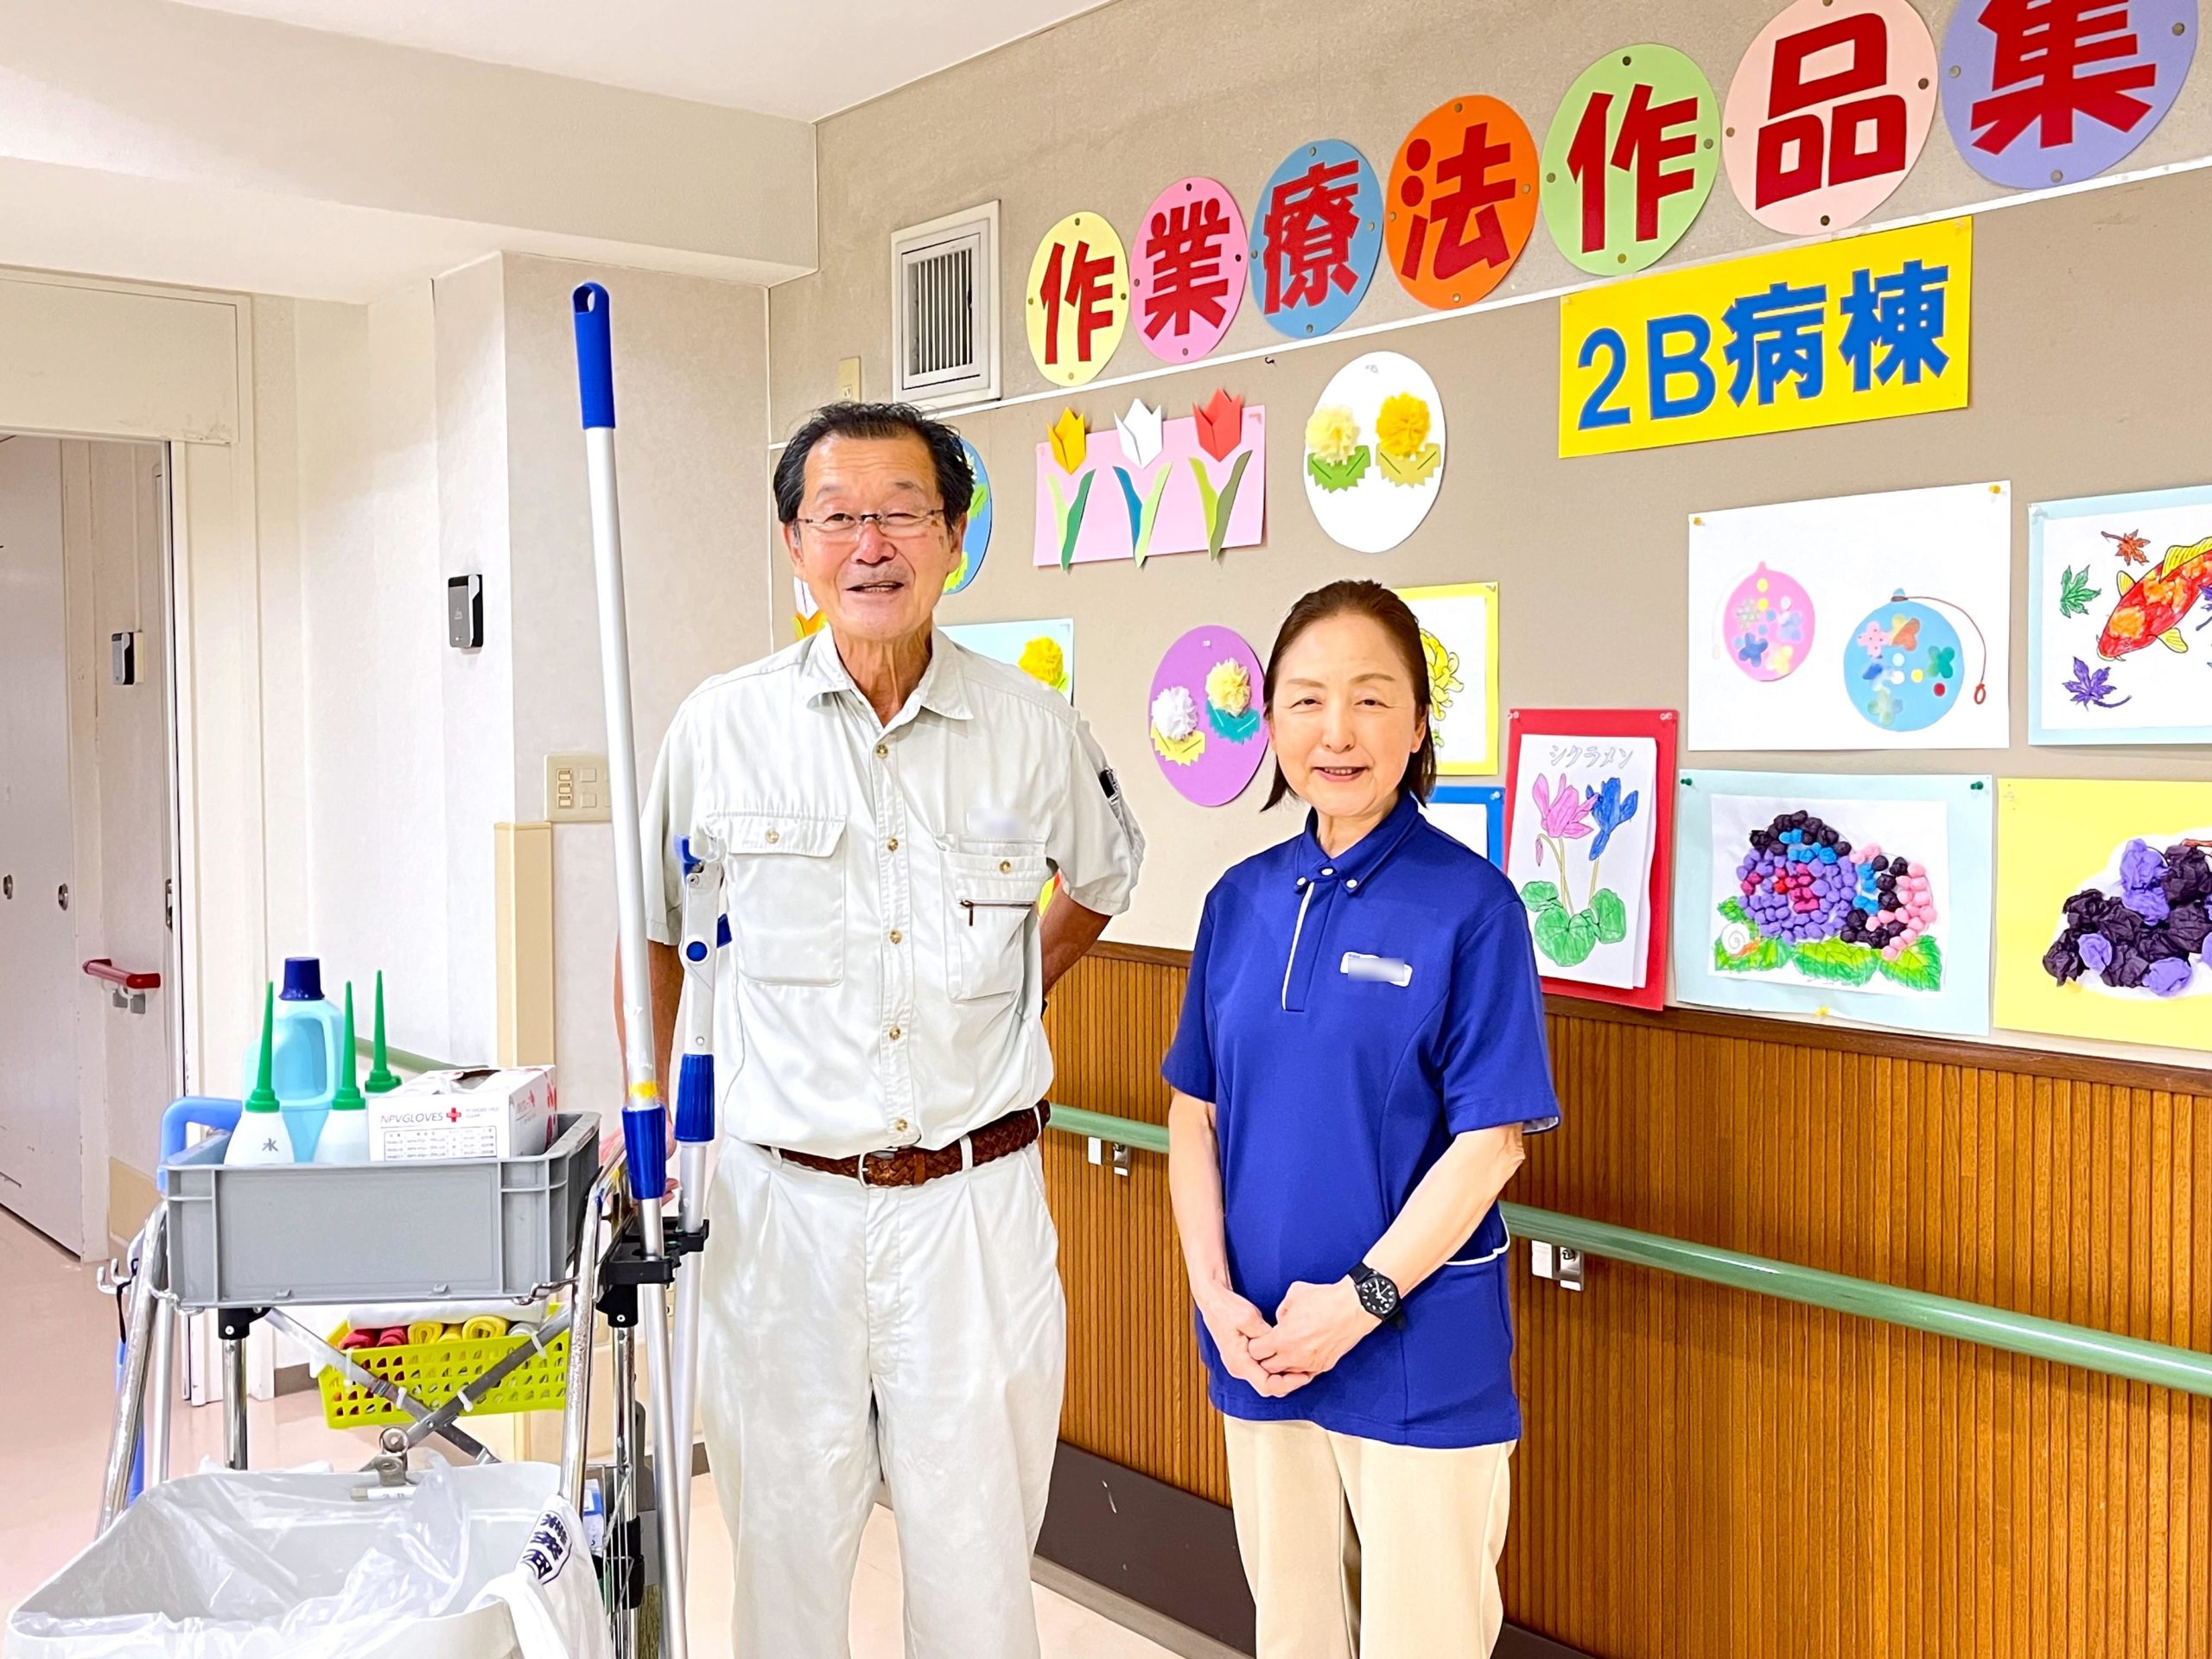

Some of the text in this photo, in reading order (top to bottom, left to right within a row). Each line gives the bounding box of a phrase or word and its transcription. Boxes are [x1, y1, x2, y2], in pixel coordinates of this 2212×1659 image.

[1041, 0, 2156, 363] 作業療法作品集
[1578, 261, 1950, 429] 2B病棟
[1549, 744, 1634, 769] シクラメン
